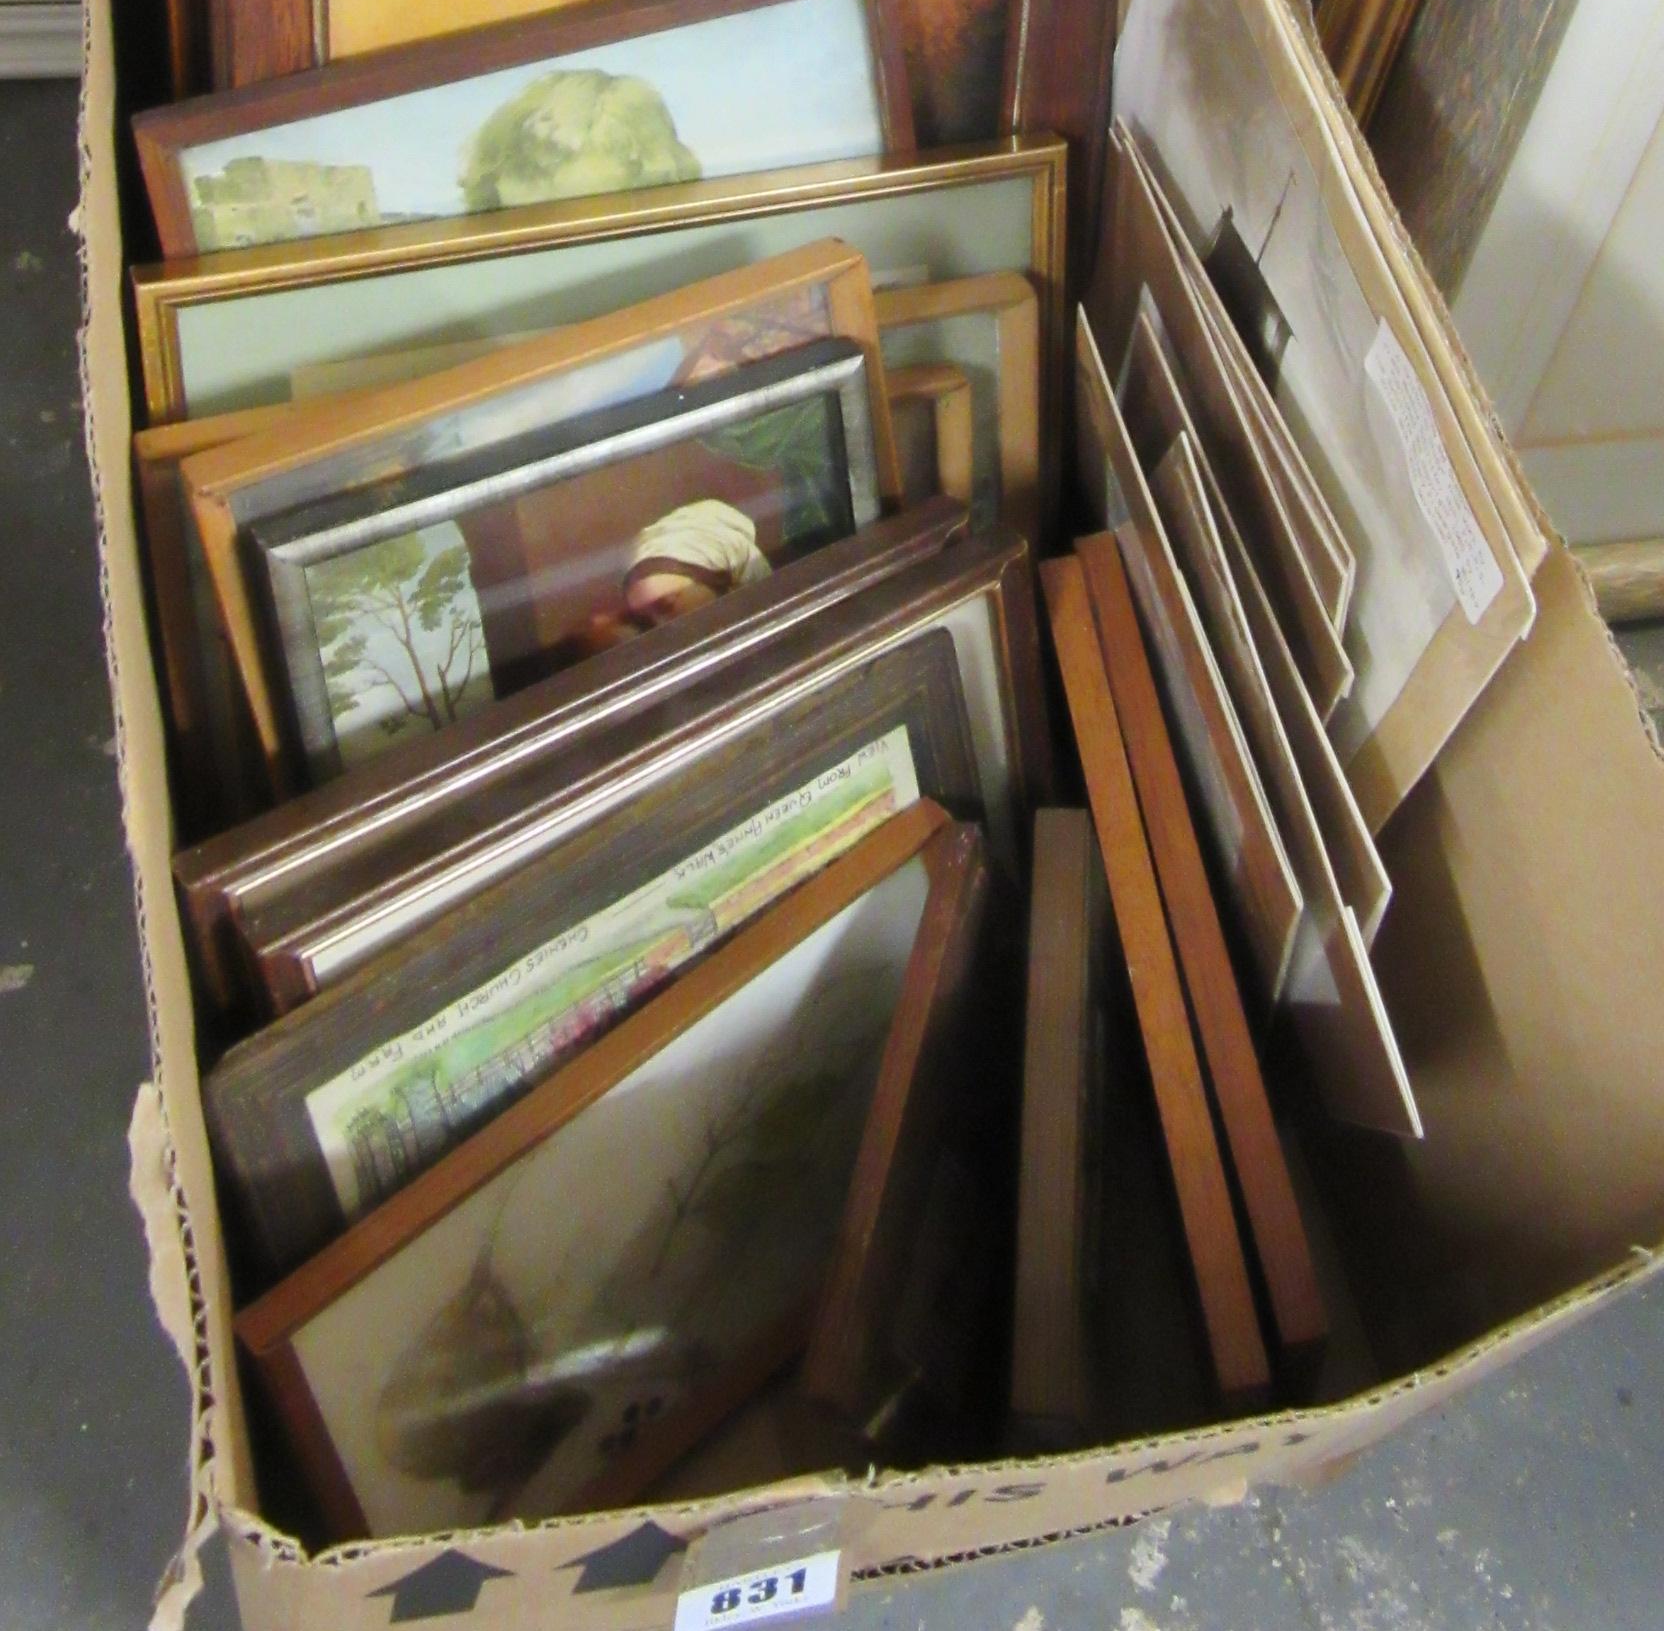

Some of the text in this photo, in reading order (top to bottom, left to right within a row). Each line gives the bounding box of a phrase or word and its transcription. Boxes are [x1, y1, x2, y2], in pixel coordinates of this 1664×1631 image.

[852, 737, 890, 768] VIEW
[814, 762, 854, 793] FROM
[761, 787, 815, 828] QUEEN
[453, 967, 525, 1018] CHURCH
[711, 1568, 807, 1614] 831
